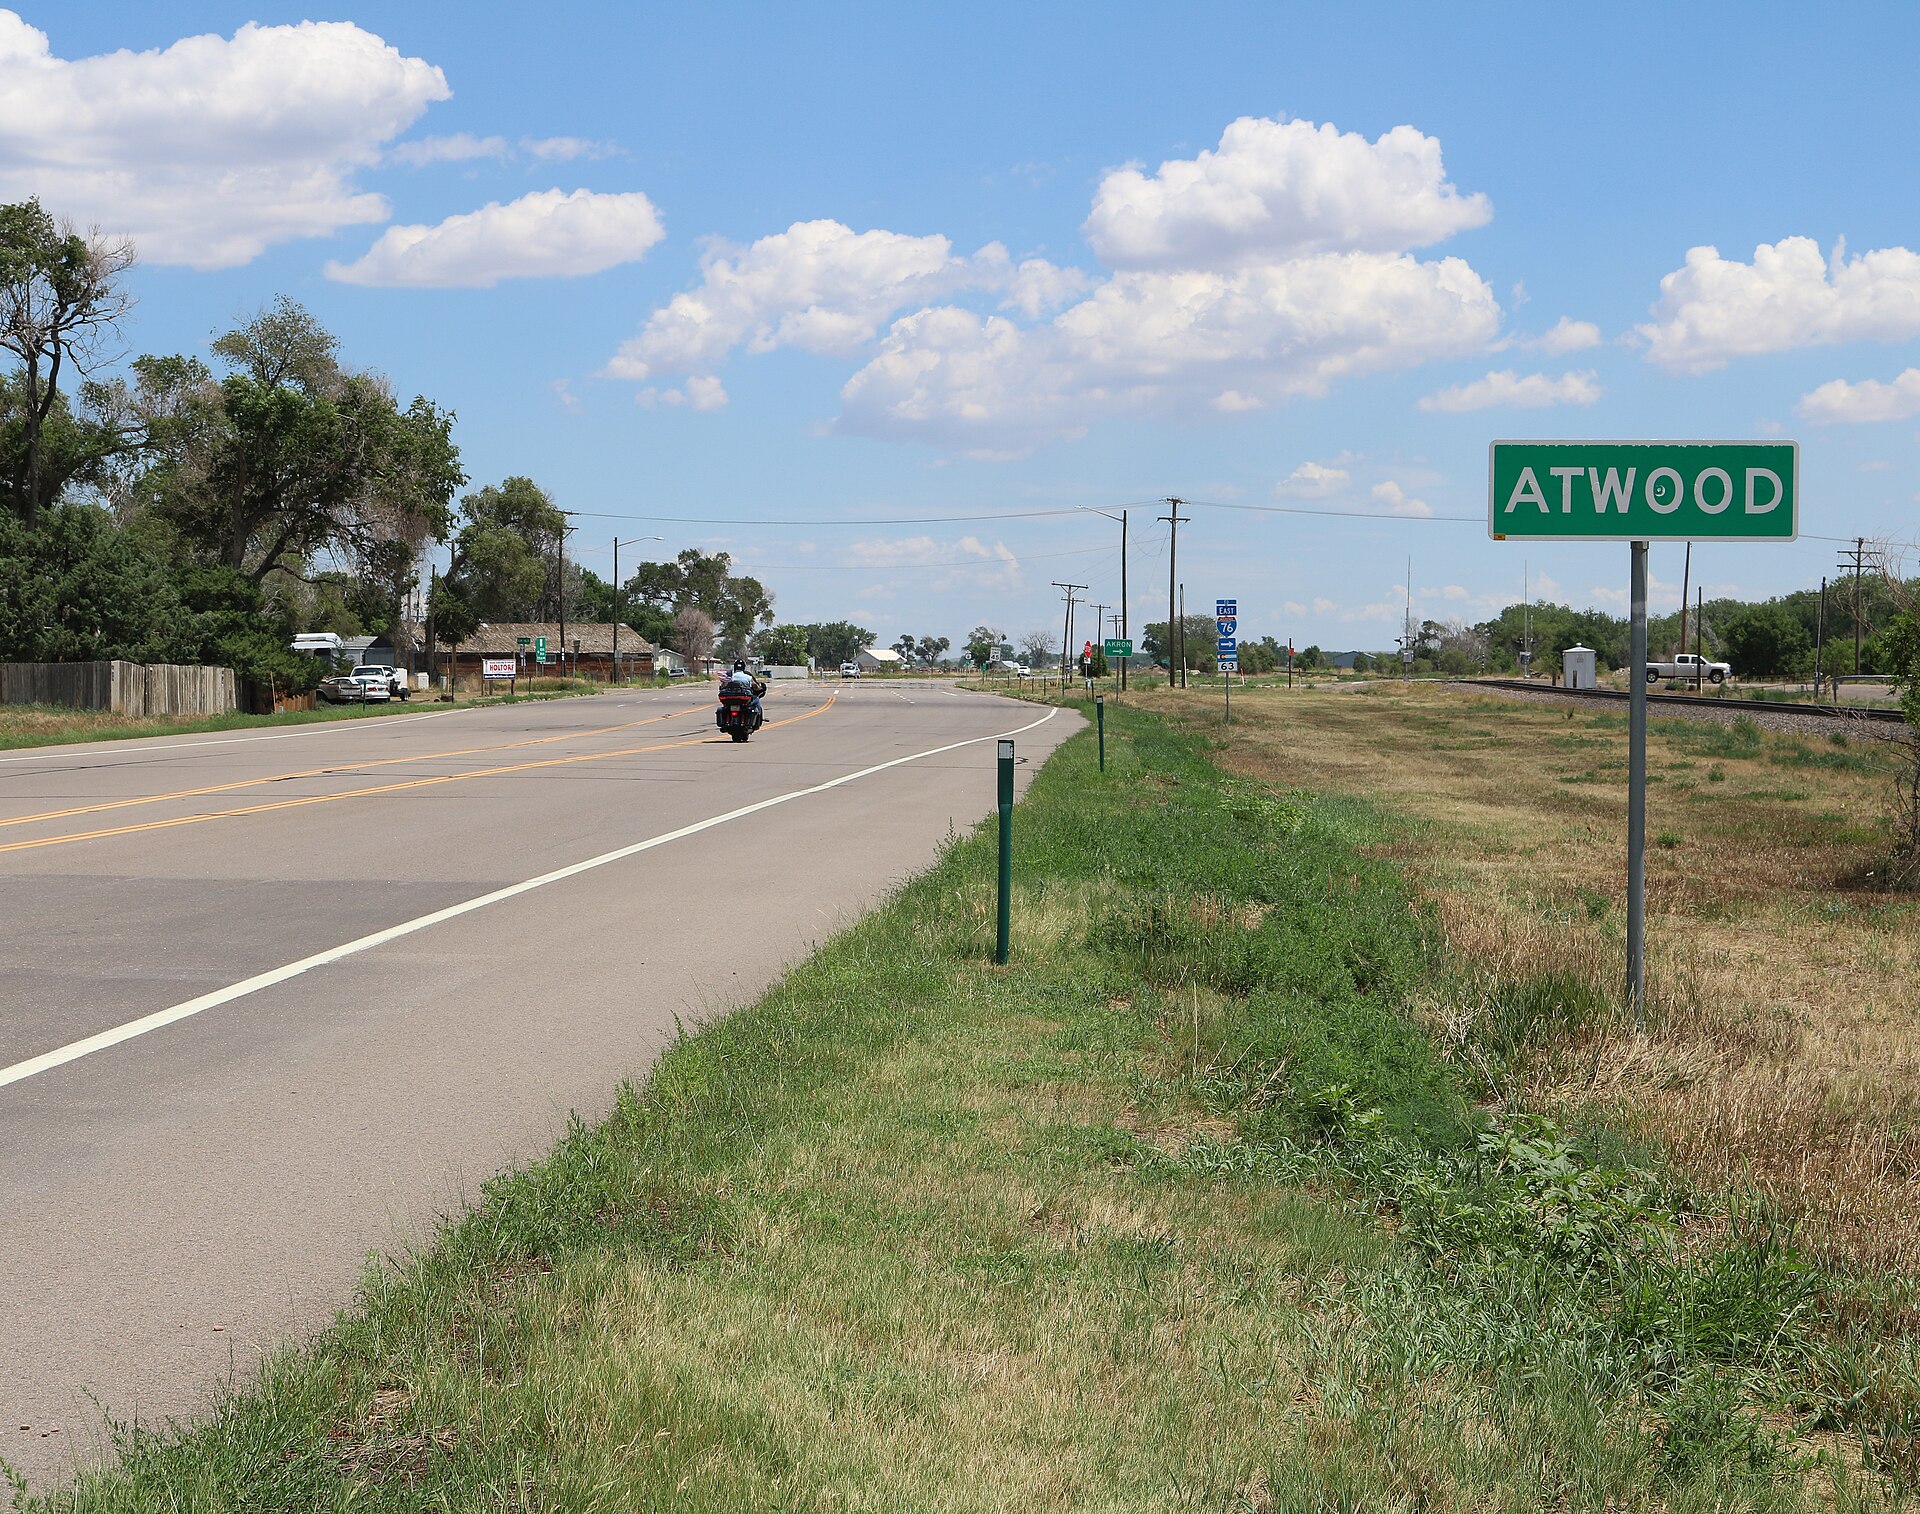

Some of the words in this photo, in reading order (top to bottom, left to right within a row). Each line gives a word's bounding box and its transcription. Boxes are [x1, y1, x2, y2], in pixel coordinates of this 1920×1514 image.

[1504, 466, 1783, 515] ATWOOD
[1219, 607, 1234, 615] EAST
[1220, 623, 1234, 633] 76
[1220, 662, 1235, 671] 63
